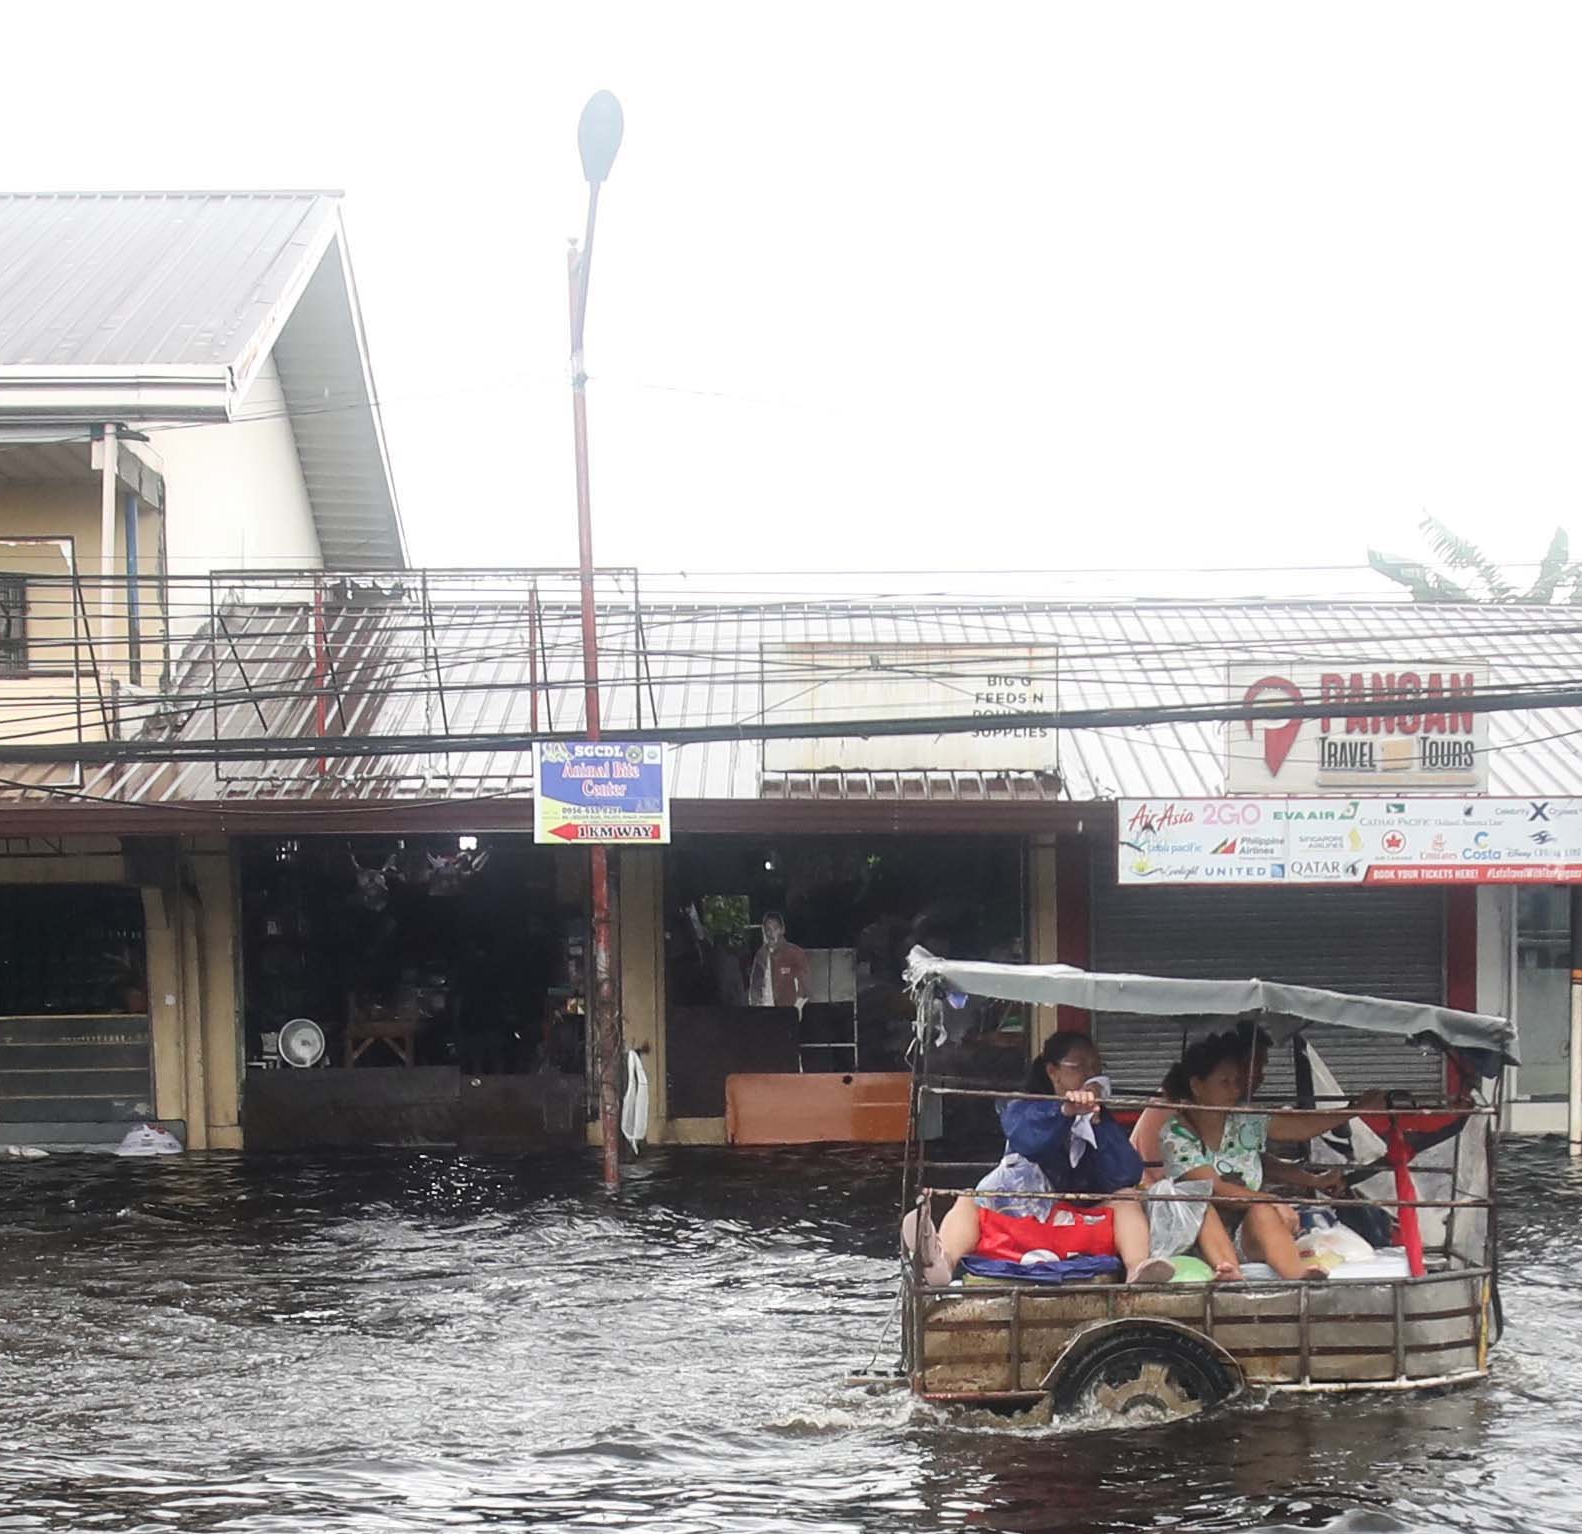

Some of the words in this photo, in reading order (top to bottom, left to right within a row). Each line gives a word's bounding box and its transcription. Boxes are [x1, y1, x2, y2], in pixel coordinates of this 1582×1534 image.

[987, 675, 1015, 686] BIG
[975, 692, 1027, 704] FEEDS
[1032, 692, 1044, 704] N
[574, 744, 624, 758] SGCDL
[1320, 736, 1377, 768] TRAVEL
[1420, 736, 1475, 768] TOURS
[562, 760, 611, 778] Animal
[612, 760, 640, 778] Bite
[581, 779, 628, 797] Center
[1203, 803, 1262, 825] 2GO
[589, 825, 613, 837] KM
[617, 825, 653, 837] WAY
[1239, 836, 1285, 849] Philippine
[1239, 846, 1274, 856] Airlines
[1462, 847, 1501, 861] Costa
[1204, 866, 1267, 877] UNITED
[1291, 860, 1341, 875] QATAR
[1373, 869, 1395, 879] BOOK
[1421, 869, 1453, 880] TICKETS
